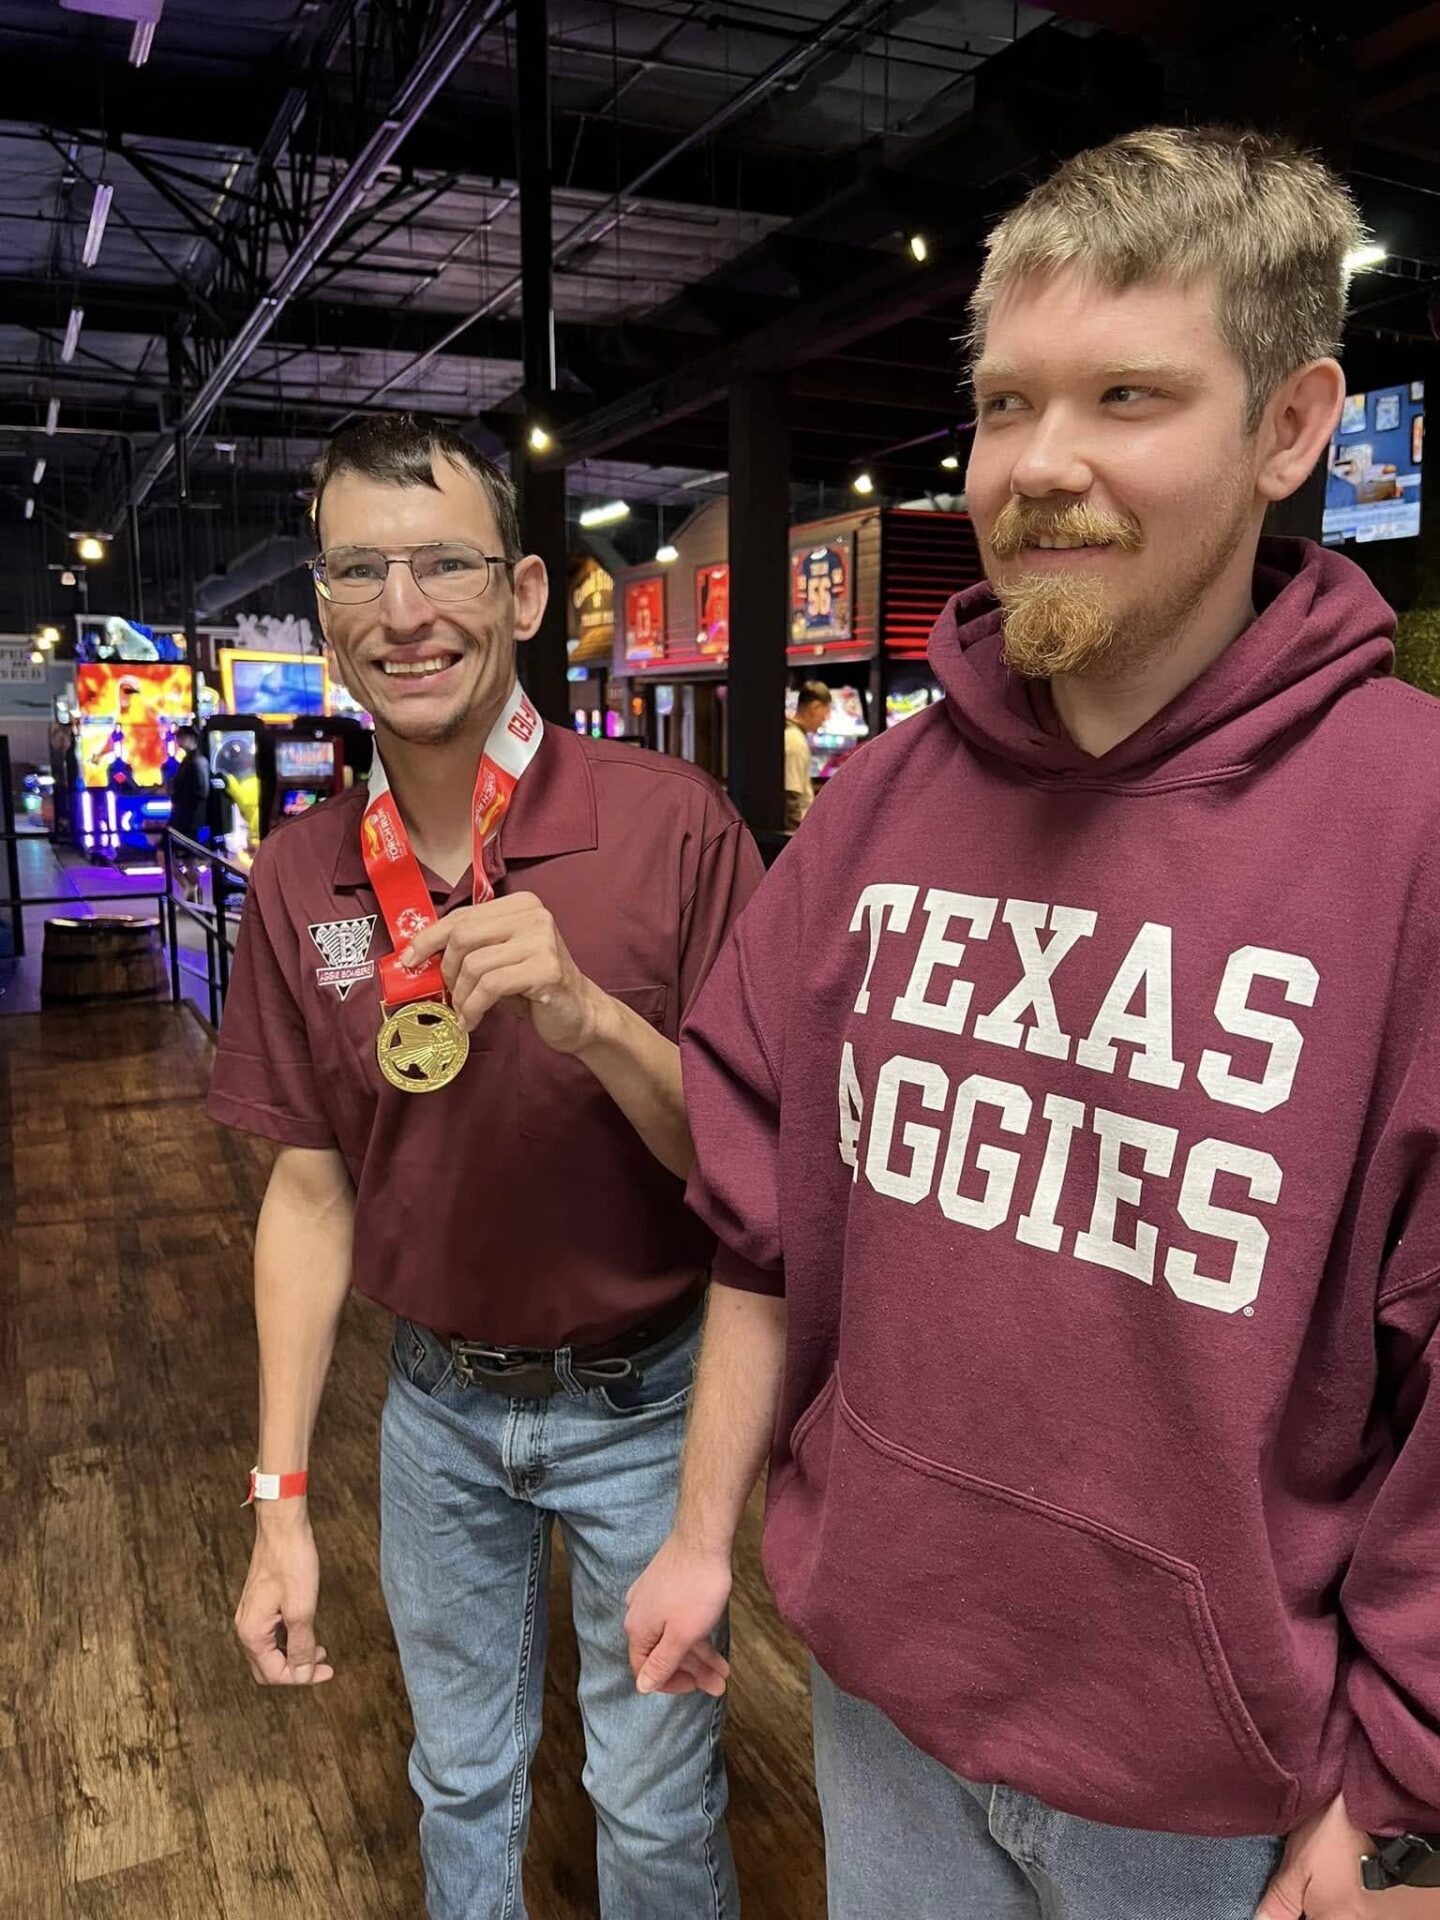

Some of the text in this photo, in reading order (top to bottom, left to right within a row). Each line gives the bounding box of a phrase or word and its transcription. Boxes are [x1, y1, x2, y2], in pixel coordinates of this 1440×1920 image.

[339, 931, 357, 963] B
[849, 883, 1320, 1114] TEXAS
[838, 1041, 1284, 1314] AGGIES
